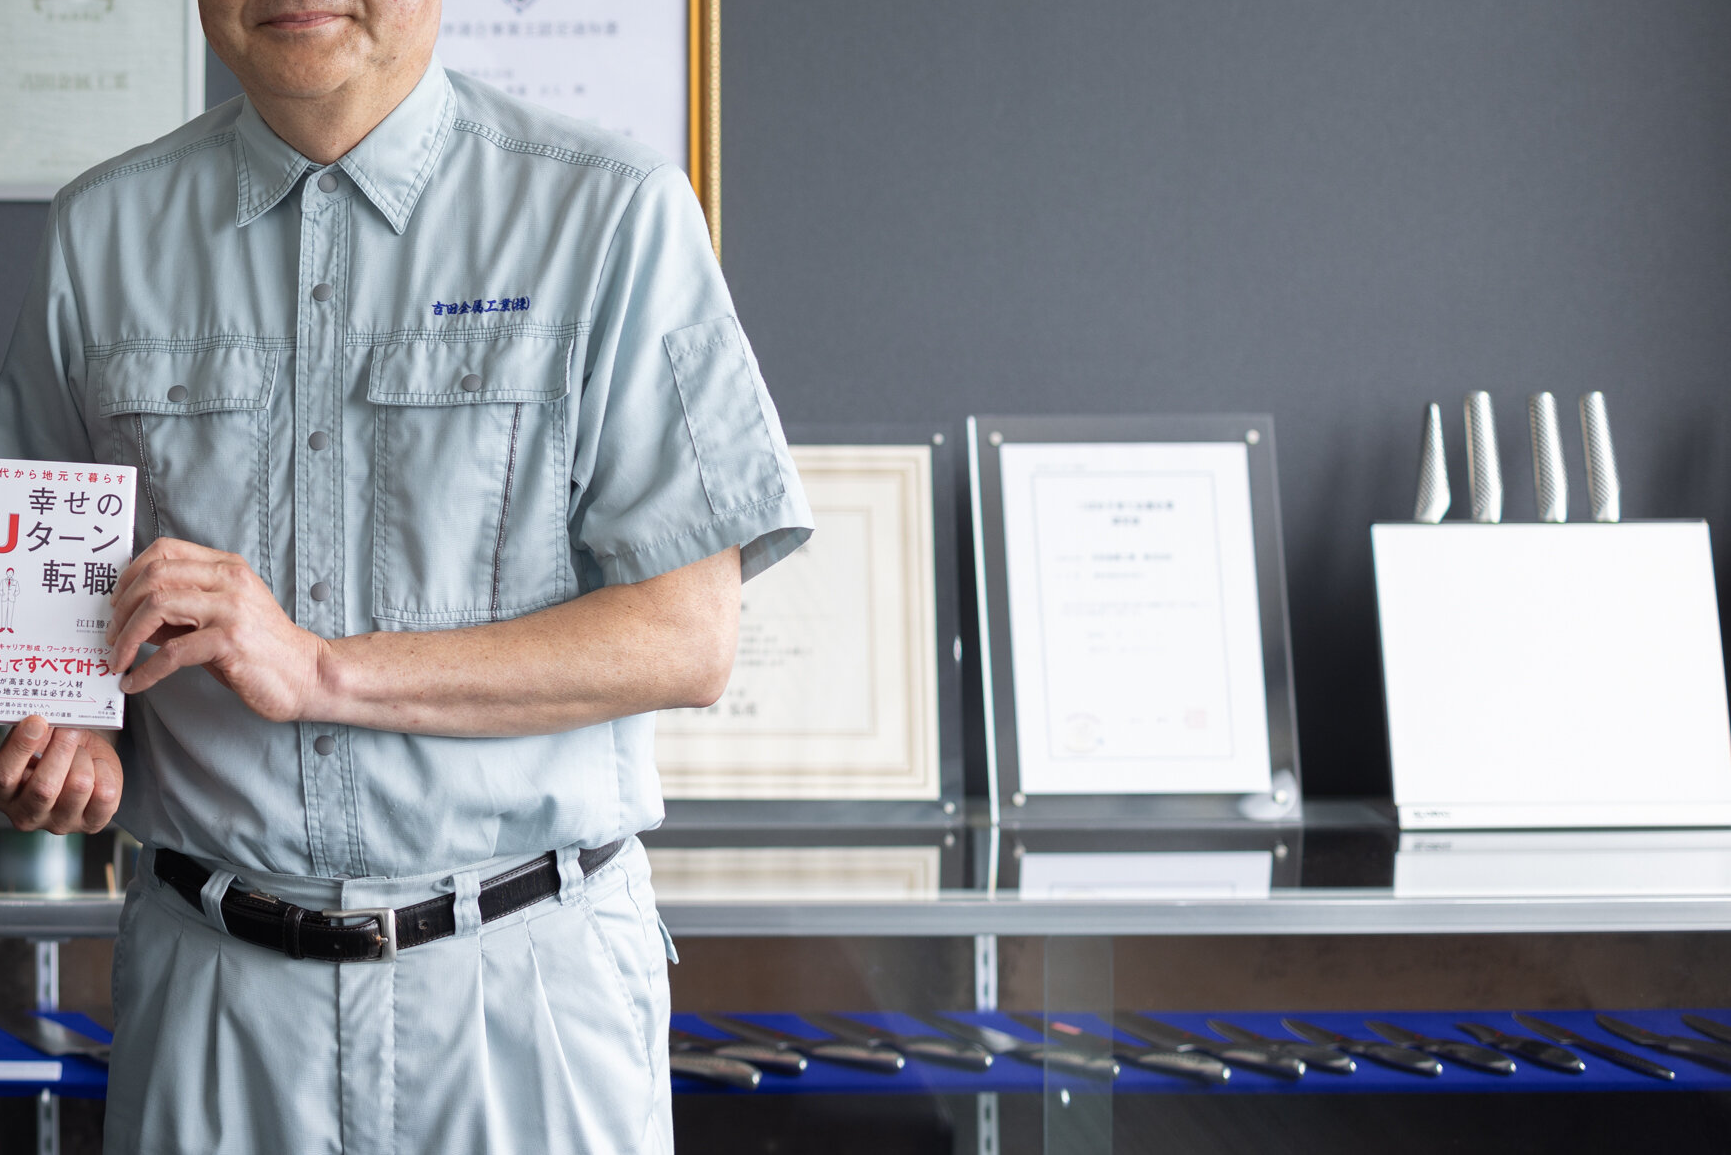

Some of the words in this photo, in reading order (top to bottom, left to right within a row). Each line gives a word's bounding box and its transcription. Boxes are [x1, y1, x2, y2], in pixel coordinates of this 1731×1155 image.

[29, 487, 123, 517] 幸せの
[42, 559, 118, 596] 転職
